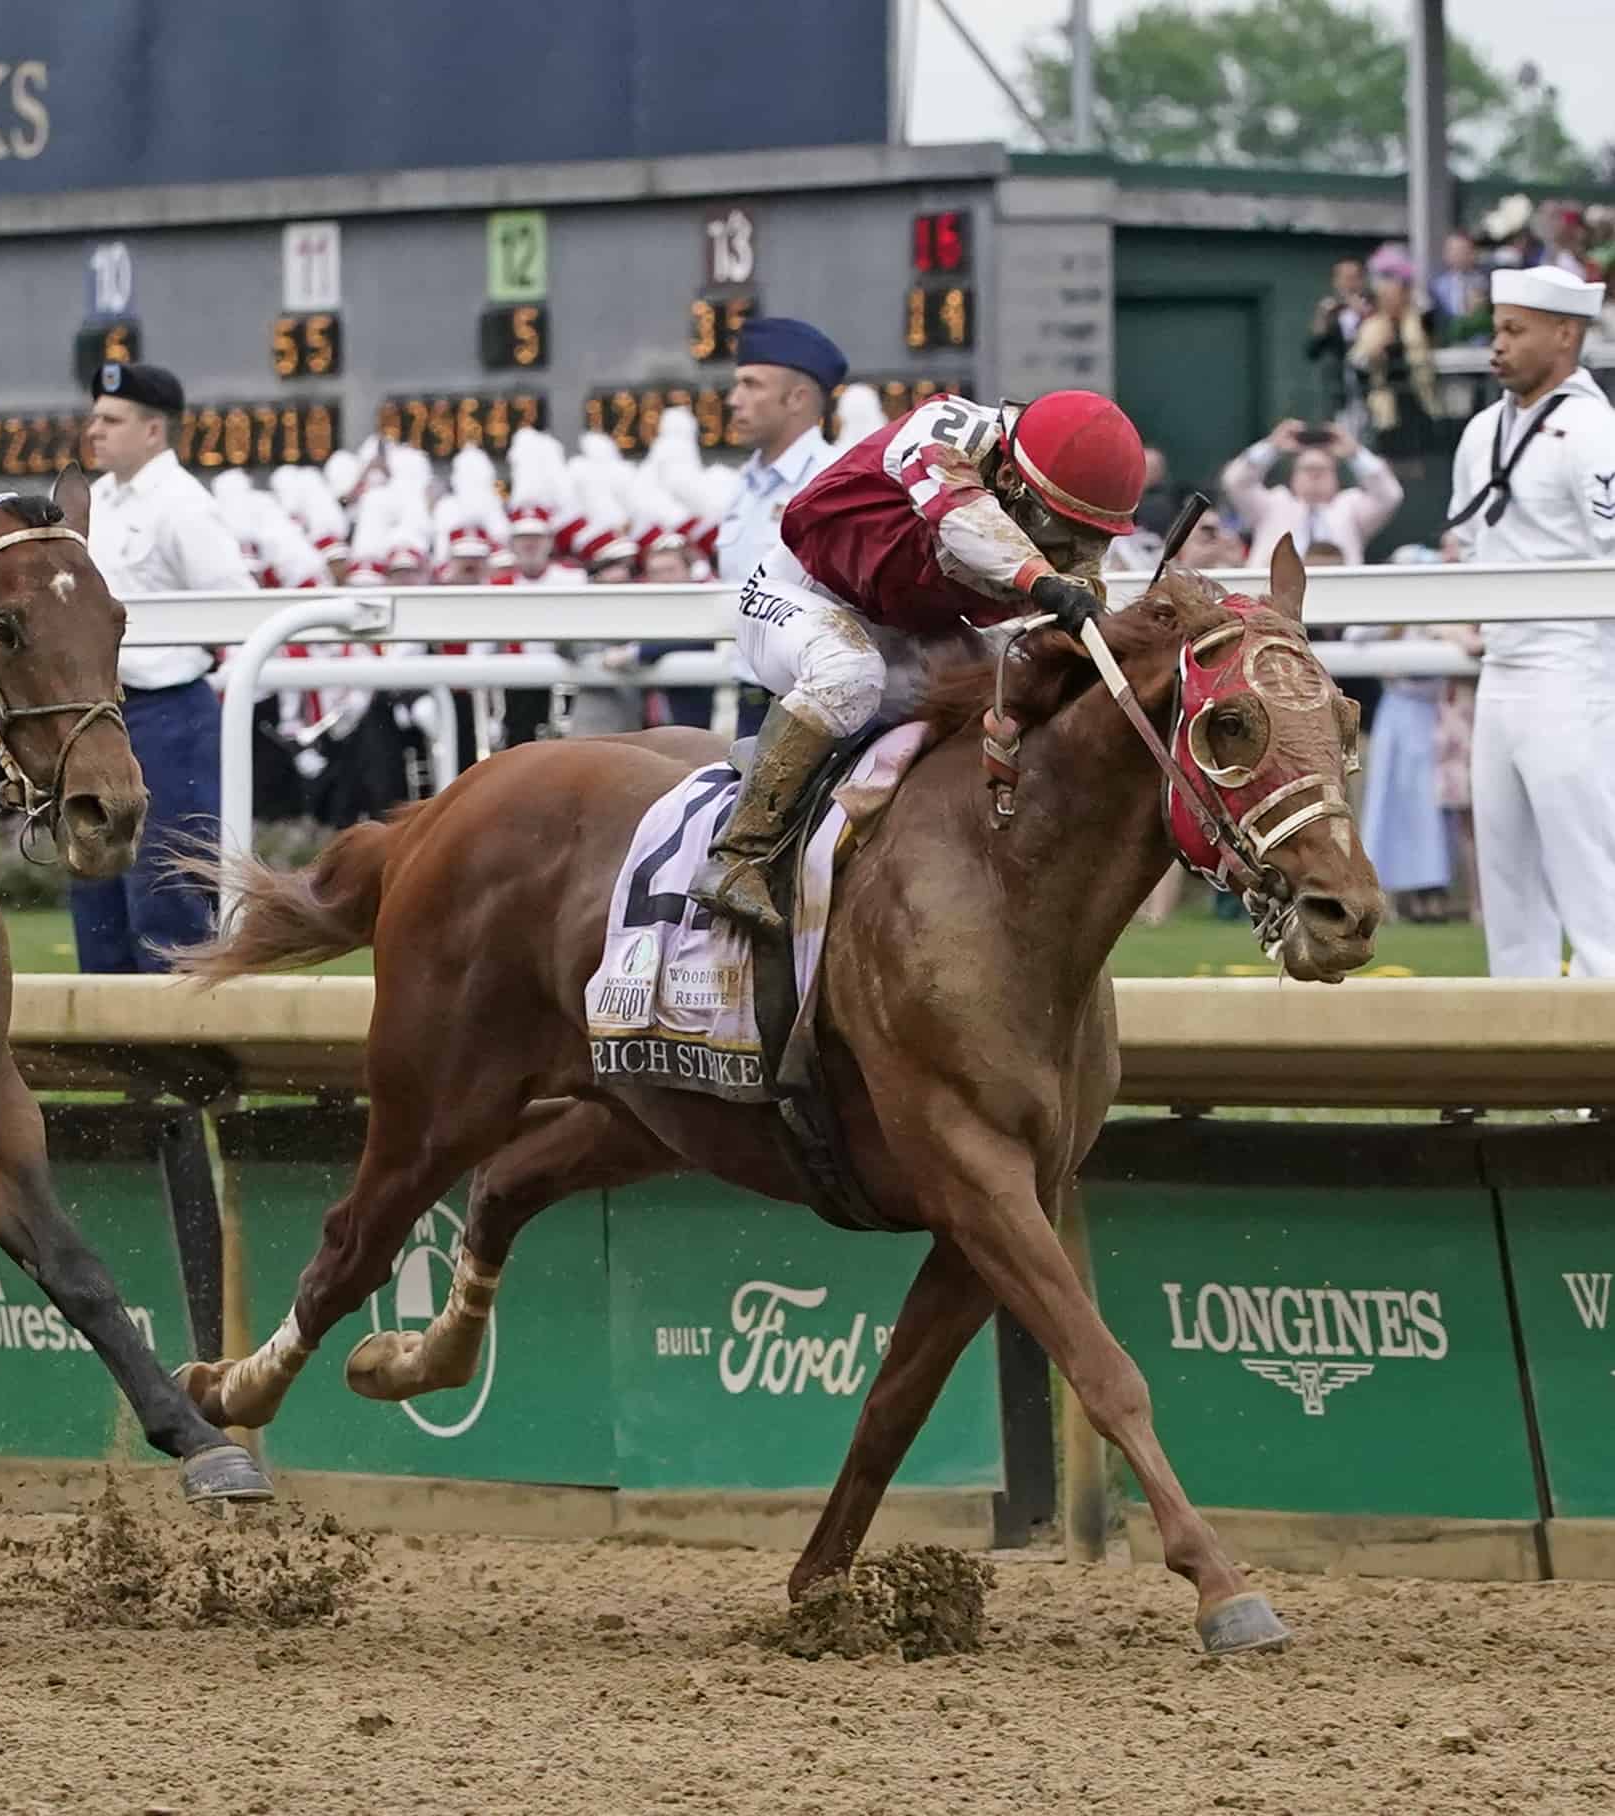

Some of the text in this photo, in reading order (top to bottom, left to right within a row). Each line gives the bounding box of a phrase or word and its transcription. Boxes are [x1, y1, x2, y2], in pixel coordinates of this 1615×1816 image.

[90, 240, 132, 314] 10
[499, 224, 537, 288] 12
[706, 208, 755, 284] 13
[931, 403, 992, 456] 21
[596, 985, 651, 1022] DERBY
[590, 1040, 672, 1073] RICH
[656, 1327, 713, 1357] BUILT
[719, 1280, 867, 1395] Ford
[1162, 1282, 1450, 1361] LONGINES
